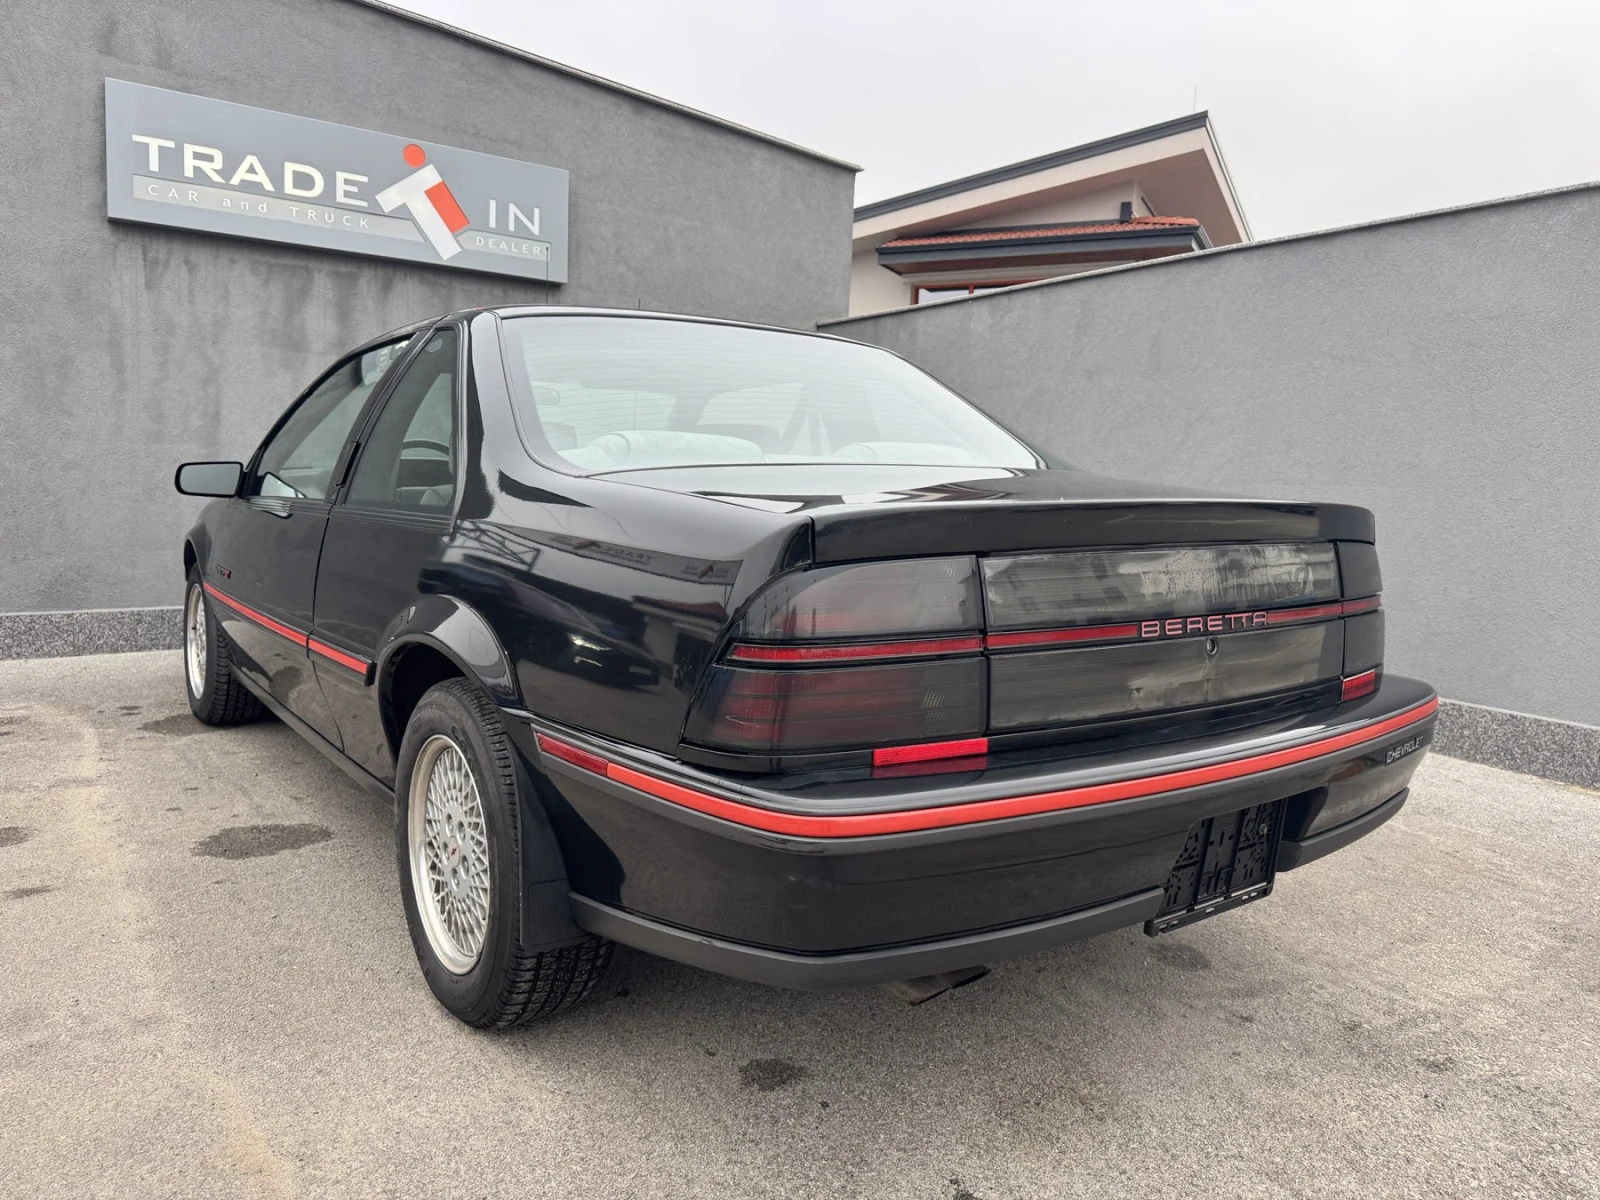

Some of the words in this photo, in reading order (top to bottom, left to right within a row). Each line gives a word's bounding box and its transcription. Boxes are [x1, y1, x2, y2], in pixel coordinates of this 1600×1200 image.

[132, 134, 368, 207] TRADE
[489, 199, 540, 236] IN
[148, 184, 199, 202] CAR
[222, 198, 267, 213] and
[289, 206, 368, 229] TRUCK
[476, 236, 541, 256] DEALER
[1140, 611, 1268, 638] BERETTA
